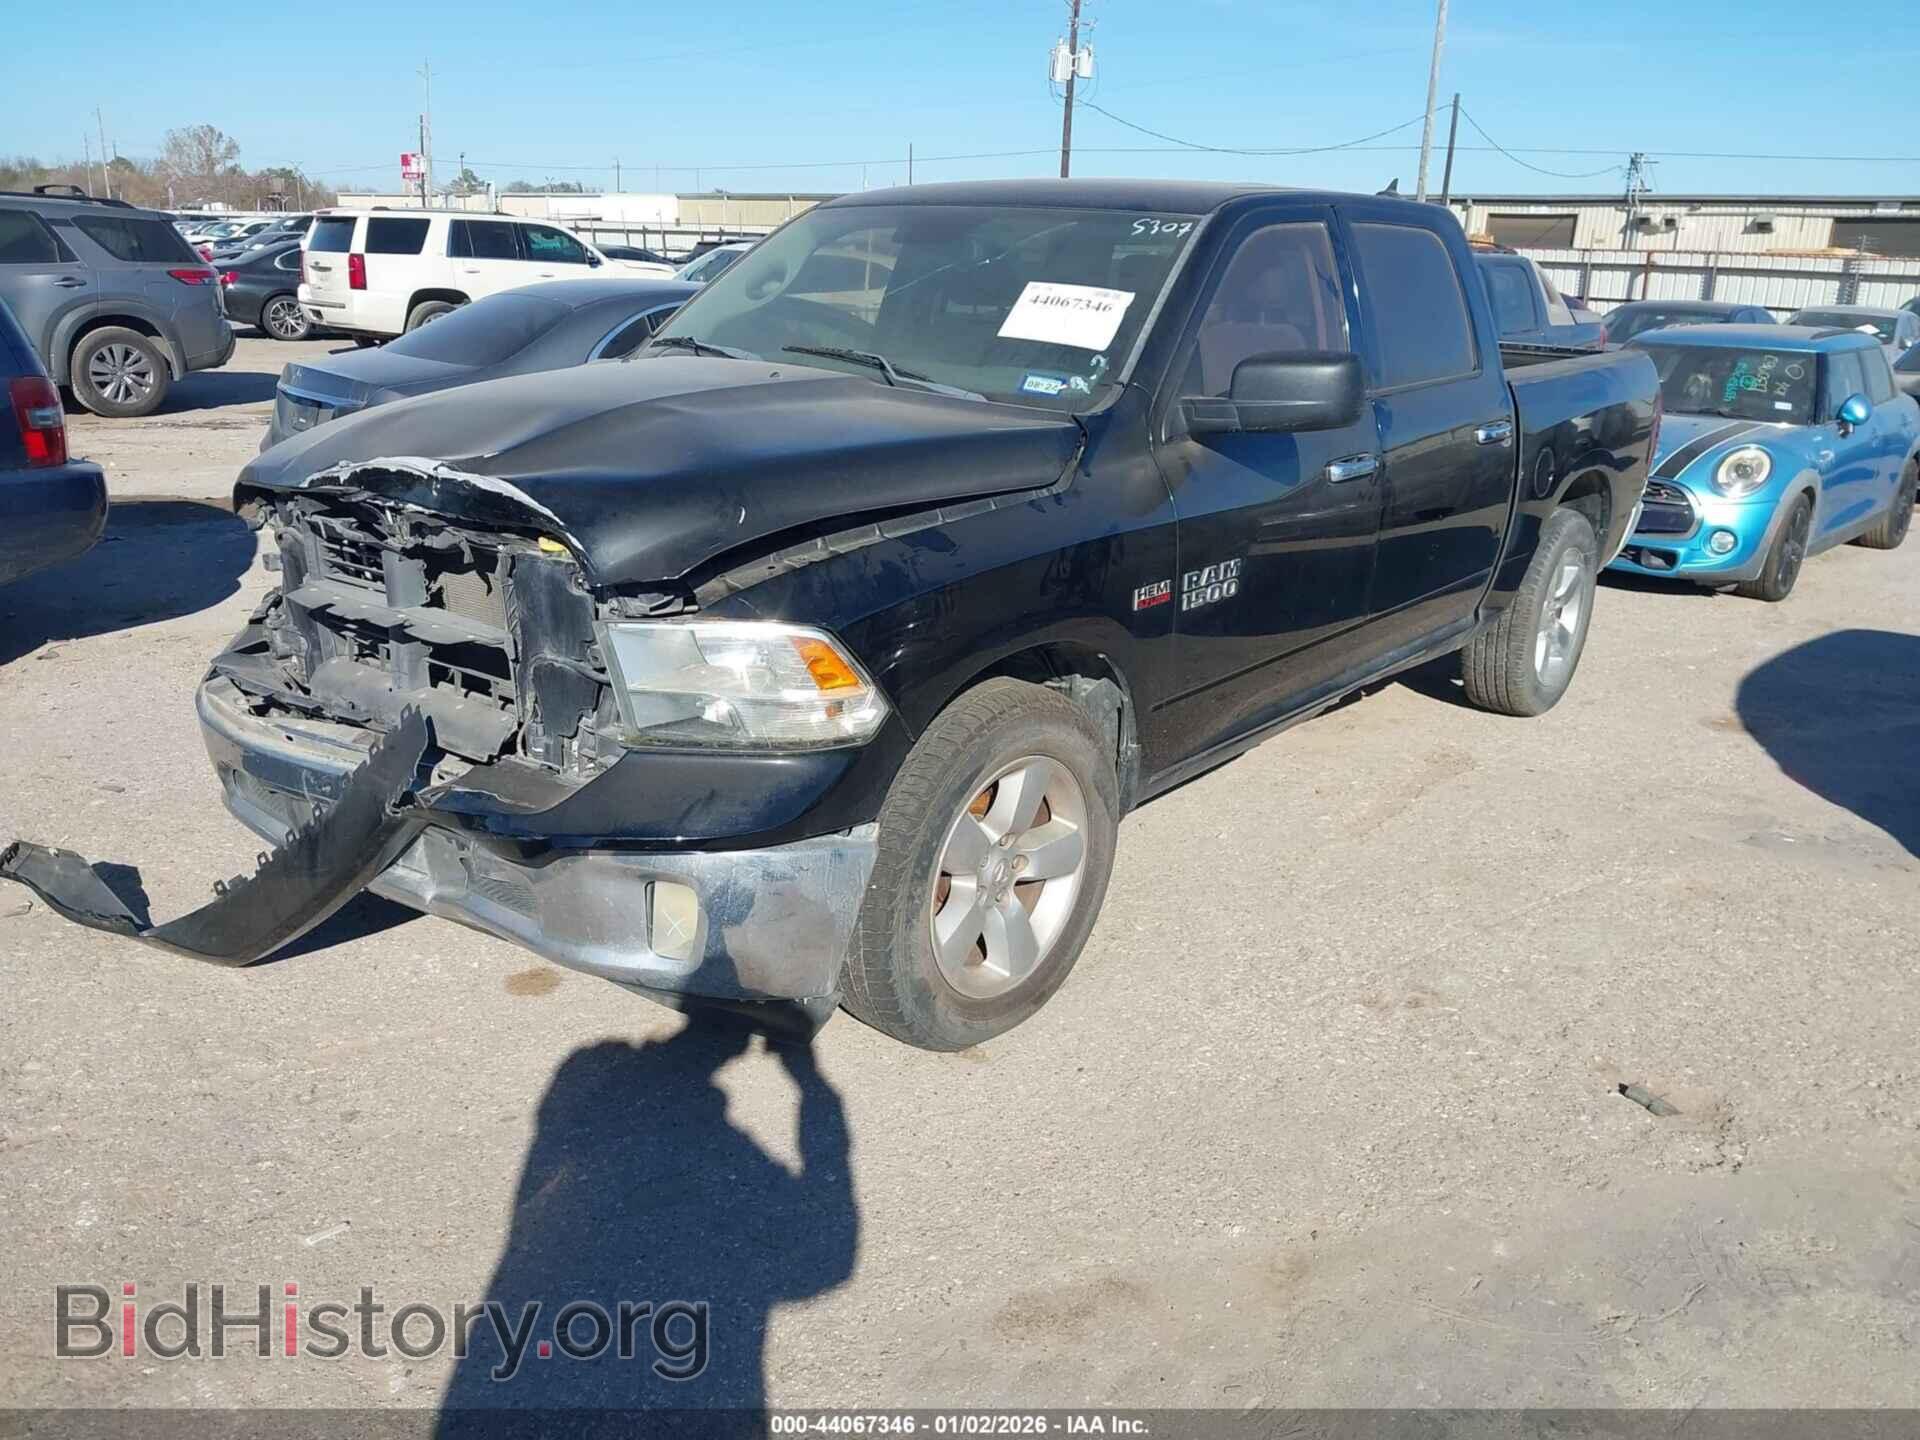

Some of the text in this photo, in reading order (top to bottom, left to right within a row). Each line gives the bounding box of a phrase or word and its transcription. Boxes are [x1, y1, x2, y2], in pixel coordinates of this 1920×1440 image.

[1028, 294, 1113, 313] 44067346
[1183, 558, 1241, 592] RAM
[1182, 578, 1240, 611] 1500
